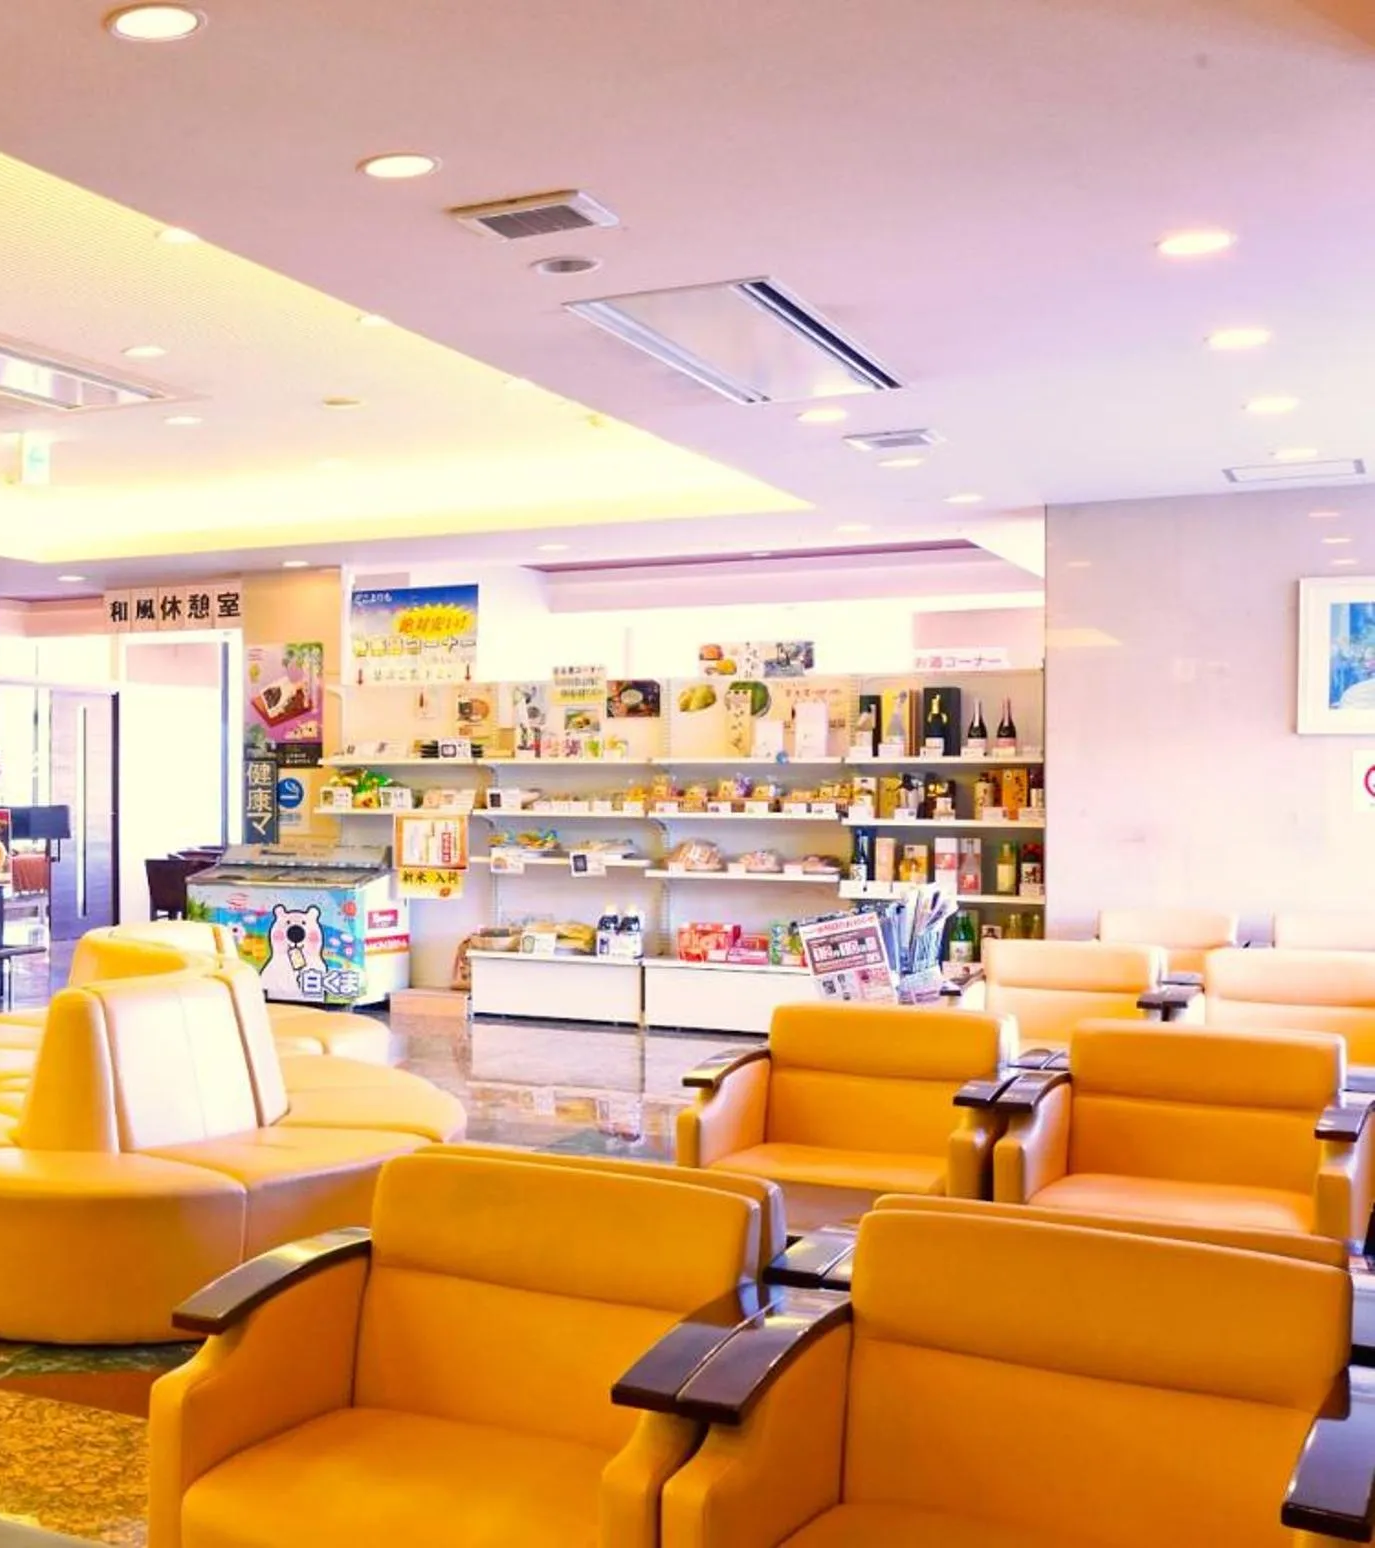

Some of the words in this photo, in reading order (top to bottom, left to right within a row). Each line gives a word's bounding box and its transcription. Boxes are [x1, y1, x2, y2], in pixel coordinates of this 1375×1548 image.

[109, 591, 241, 622] 和風休憩室
[247, 762, 272, 836] 健康マ
[301, 968, 360, 997] 白くま
